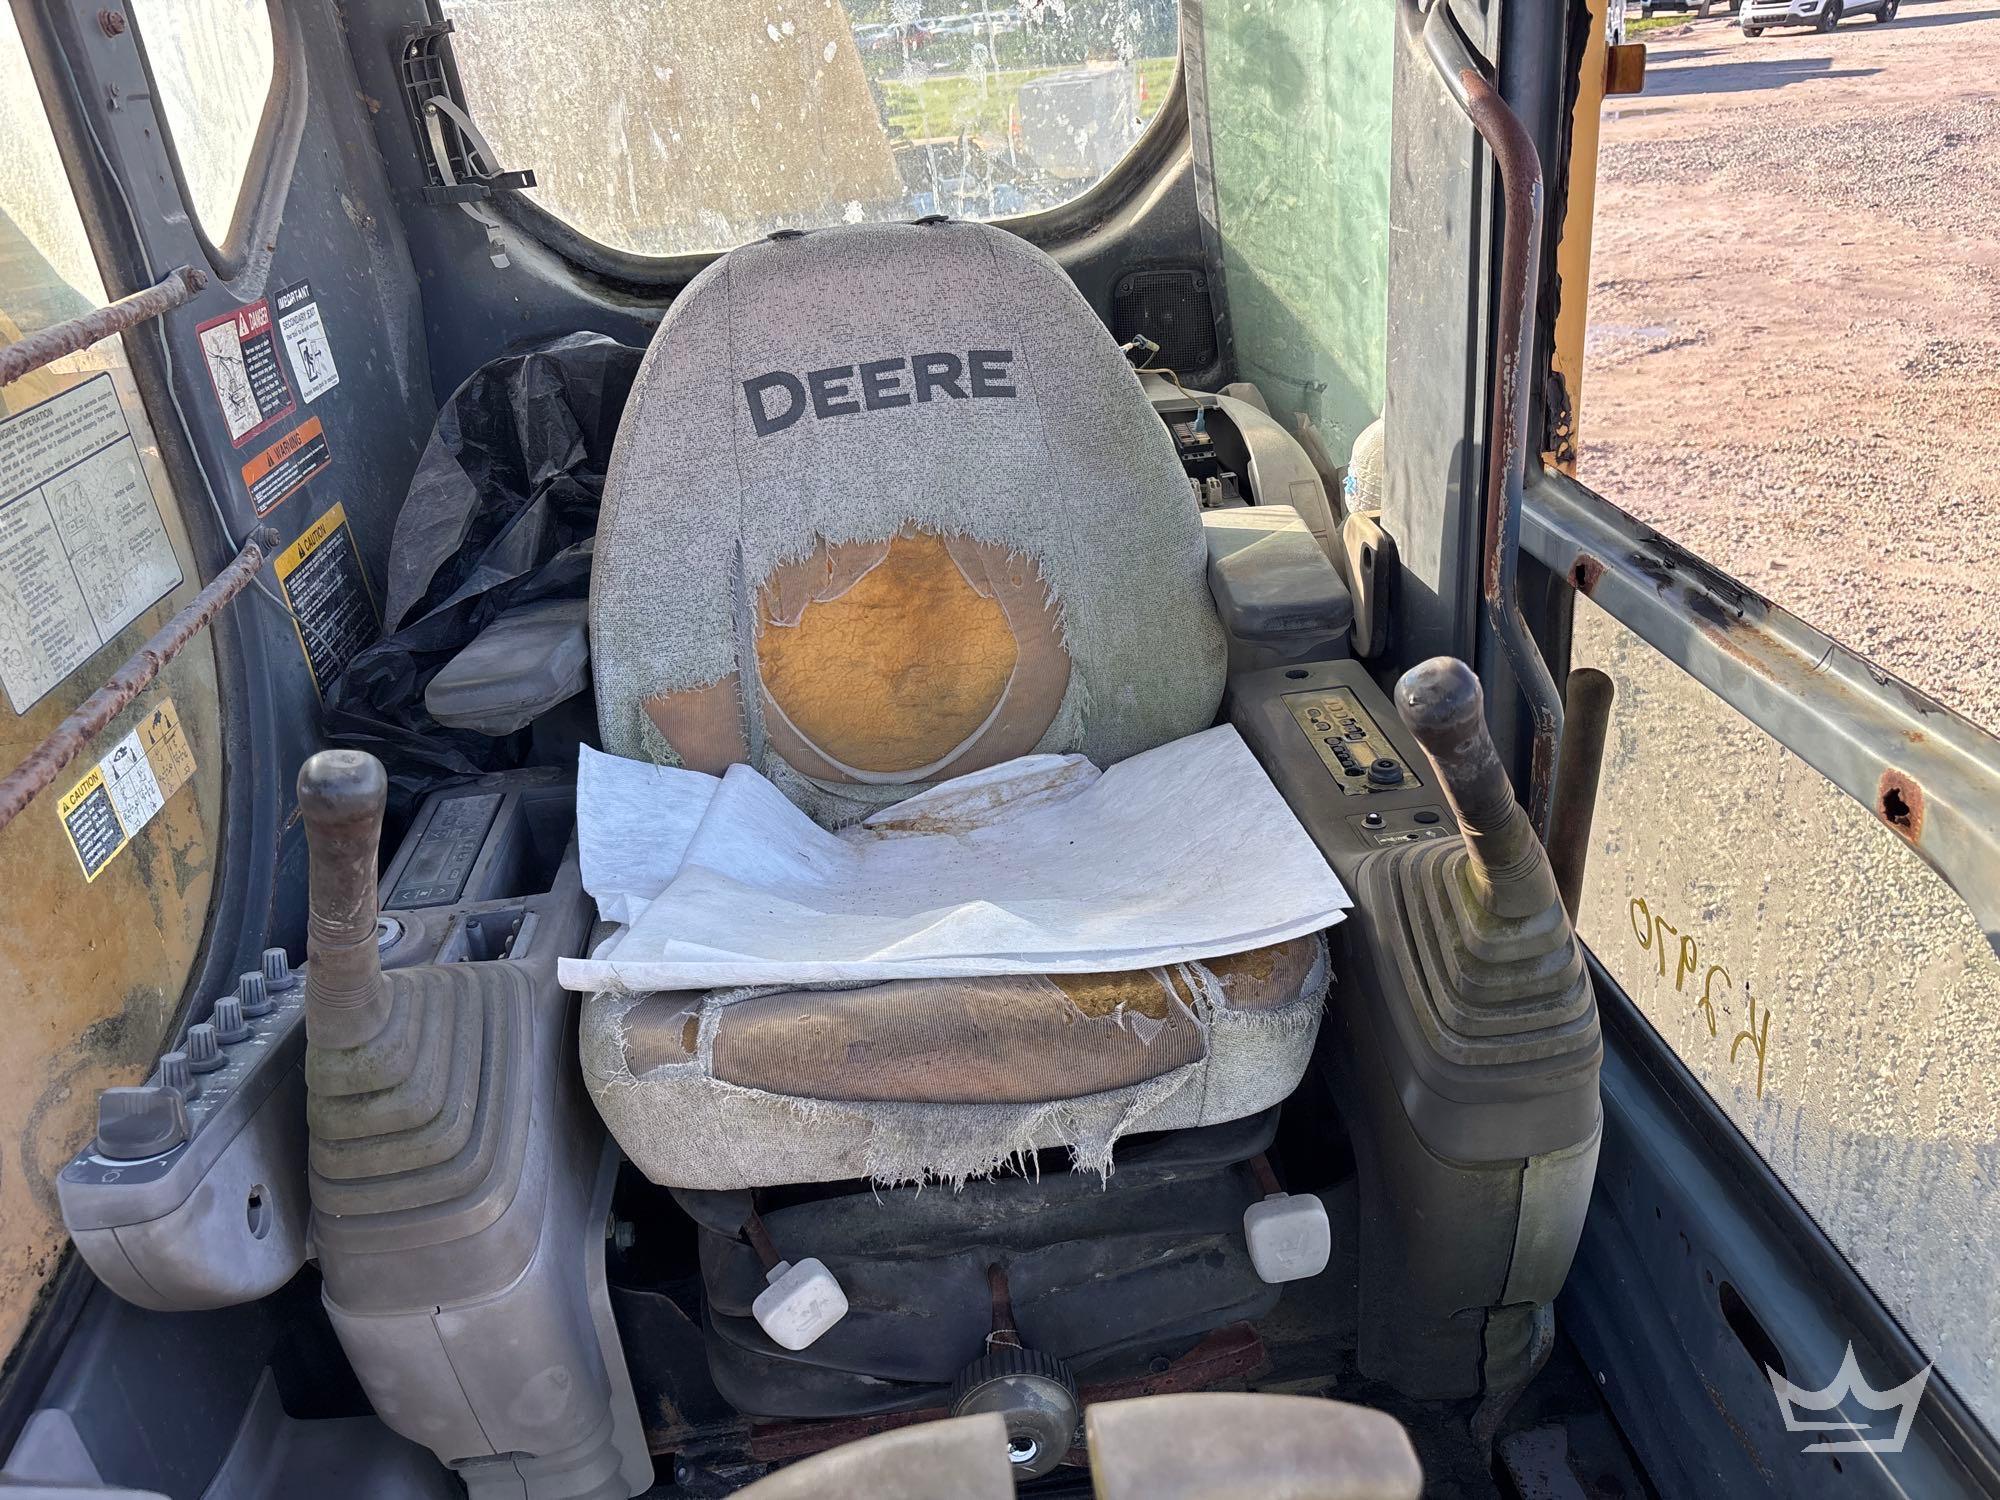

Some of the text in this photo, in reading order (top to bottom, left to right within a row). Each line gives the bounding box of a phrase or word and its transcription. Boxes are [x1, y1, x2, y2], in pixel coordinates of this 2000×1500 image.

[277, 285, 310, 310] IMPORTANT
[248, 306, 269, 331] DANGER
[282, 307, 316, 330] SECONDARY EXIT
[743, 350, 1017, 437] DEERE
[19, 408, 54, 430] OPERATION
[273, 432, 303, 460] WARNING
[304, 523, 327, 551] CAUTION
[69, 772, 99, 805] CAUTION
